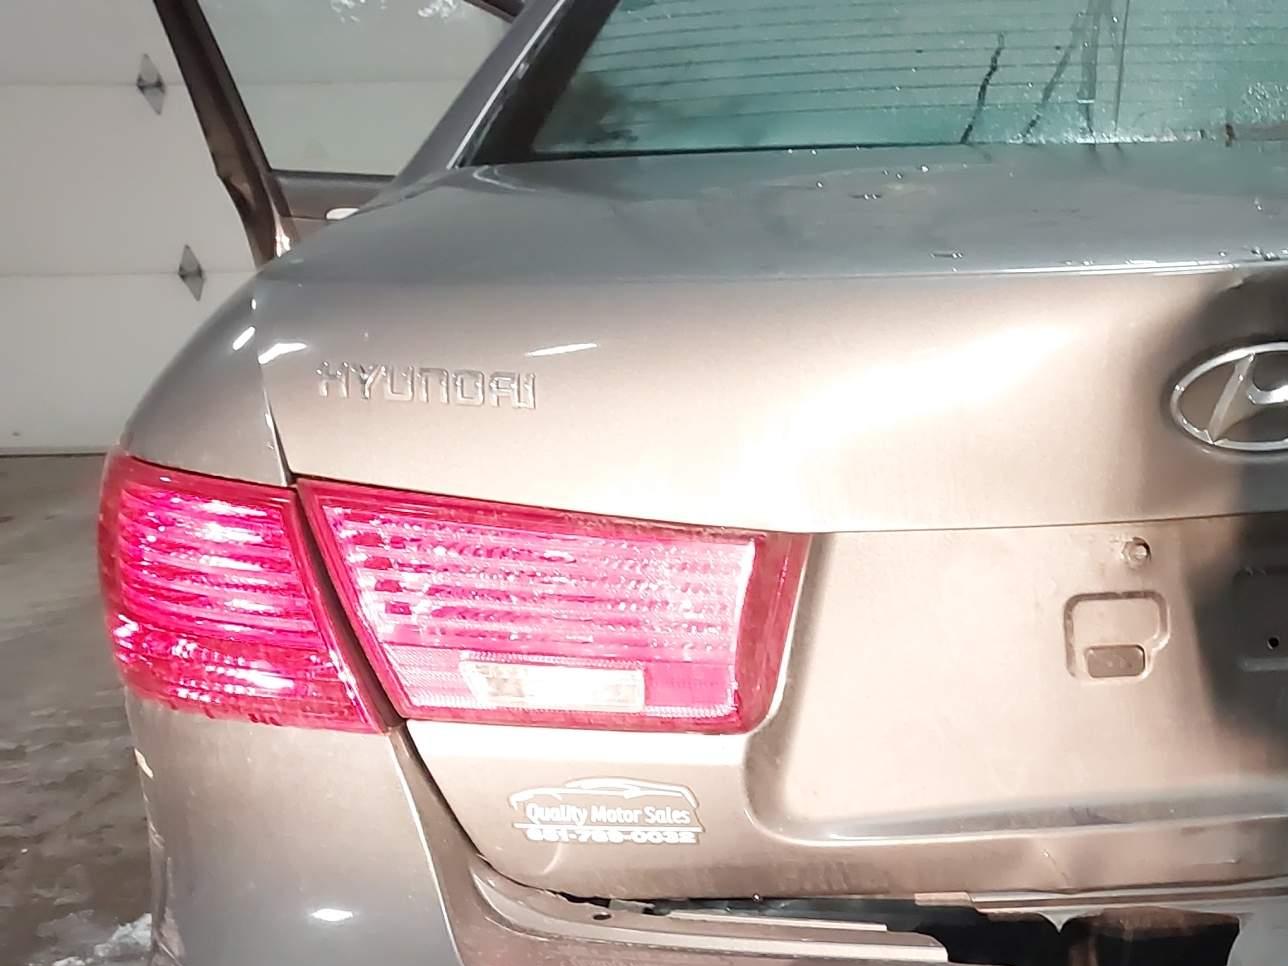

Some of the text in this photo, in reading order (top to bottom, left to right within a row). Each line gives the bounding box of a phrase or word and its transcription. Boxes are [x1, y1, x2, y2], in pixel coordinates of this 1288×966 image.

[315, 360, 537, 409] HYUNDAI
[525, 803, 691, 825] Quality Motor Sales
